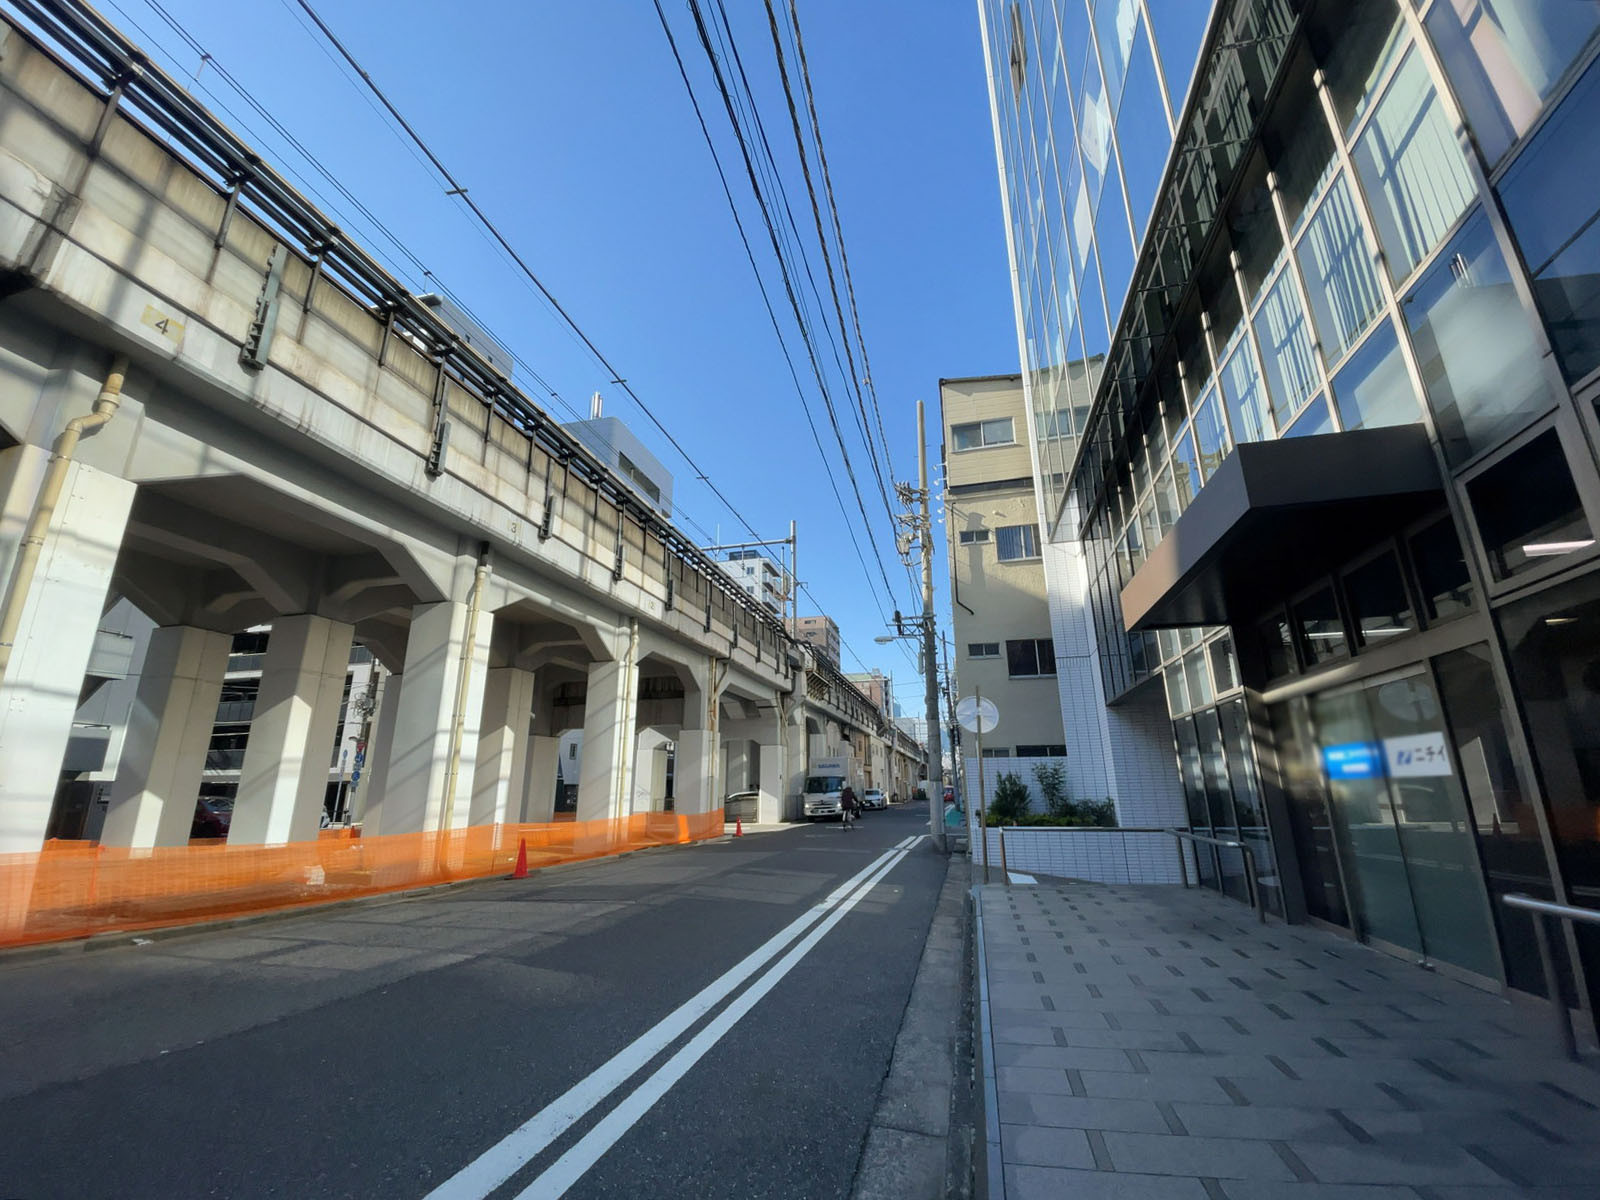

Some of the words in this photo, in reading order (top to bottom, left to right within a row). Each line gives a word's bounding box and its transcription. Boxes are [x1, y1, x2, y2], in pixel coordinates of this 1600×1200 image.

[154, 318, 169, 335] 4
[1415, 745, 1446, 762] ニチイ
